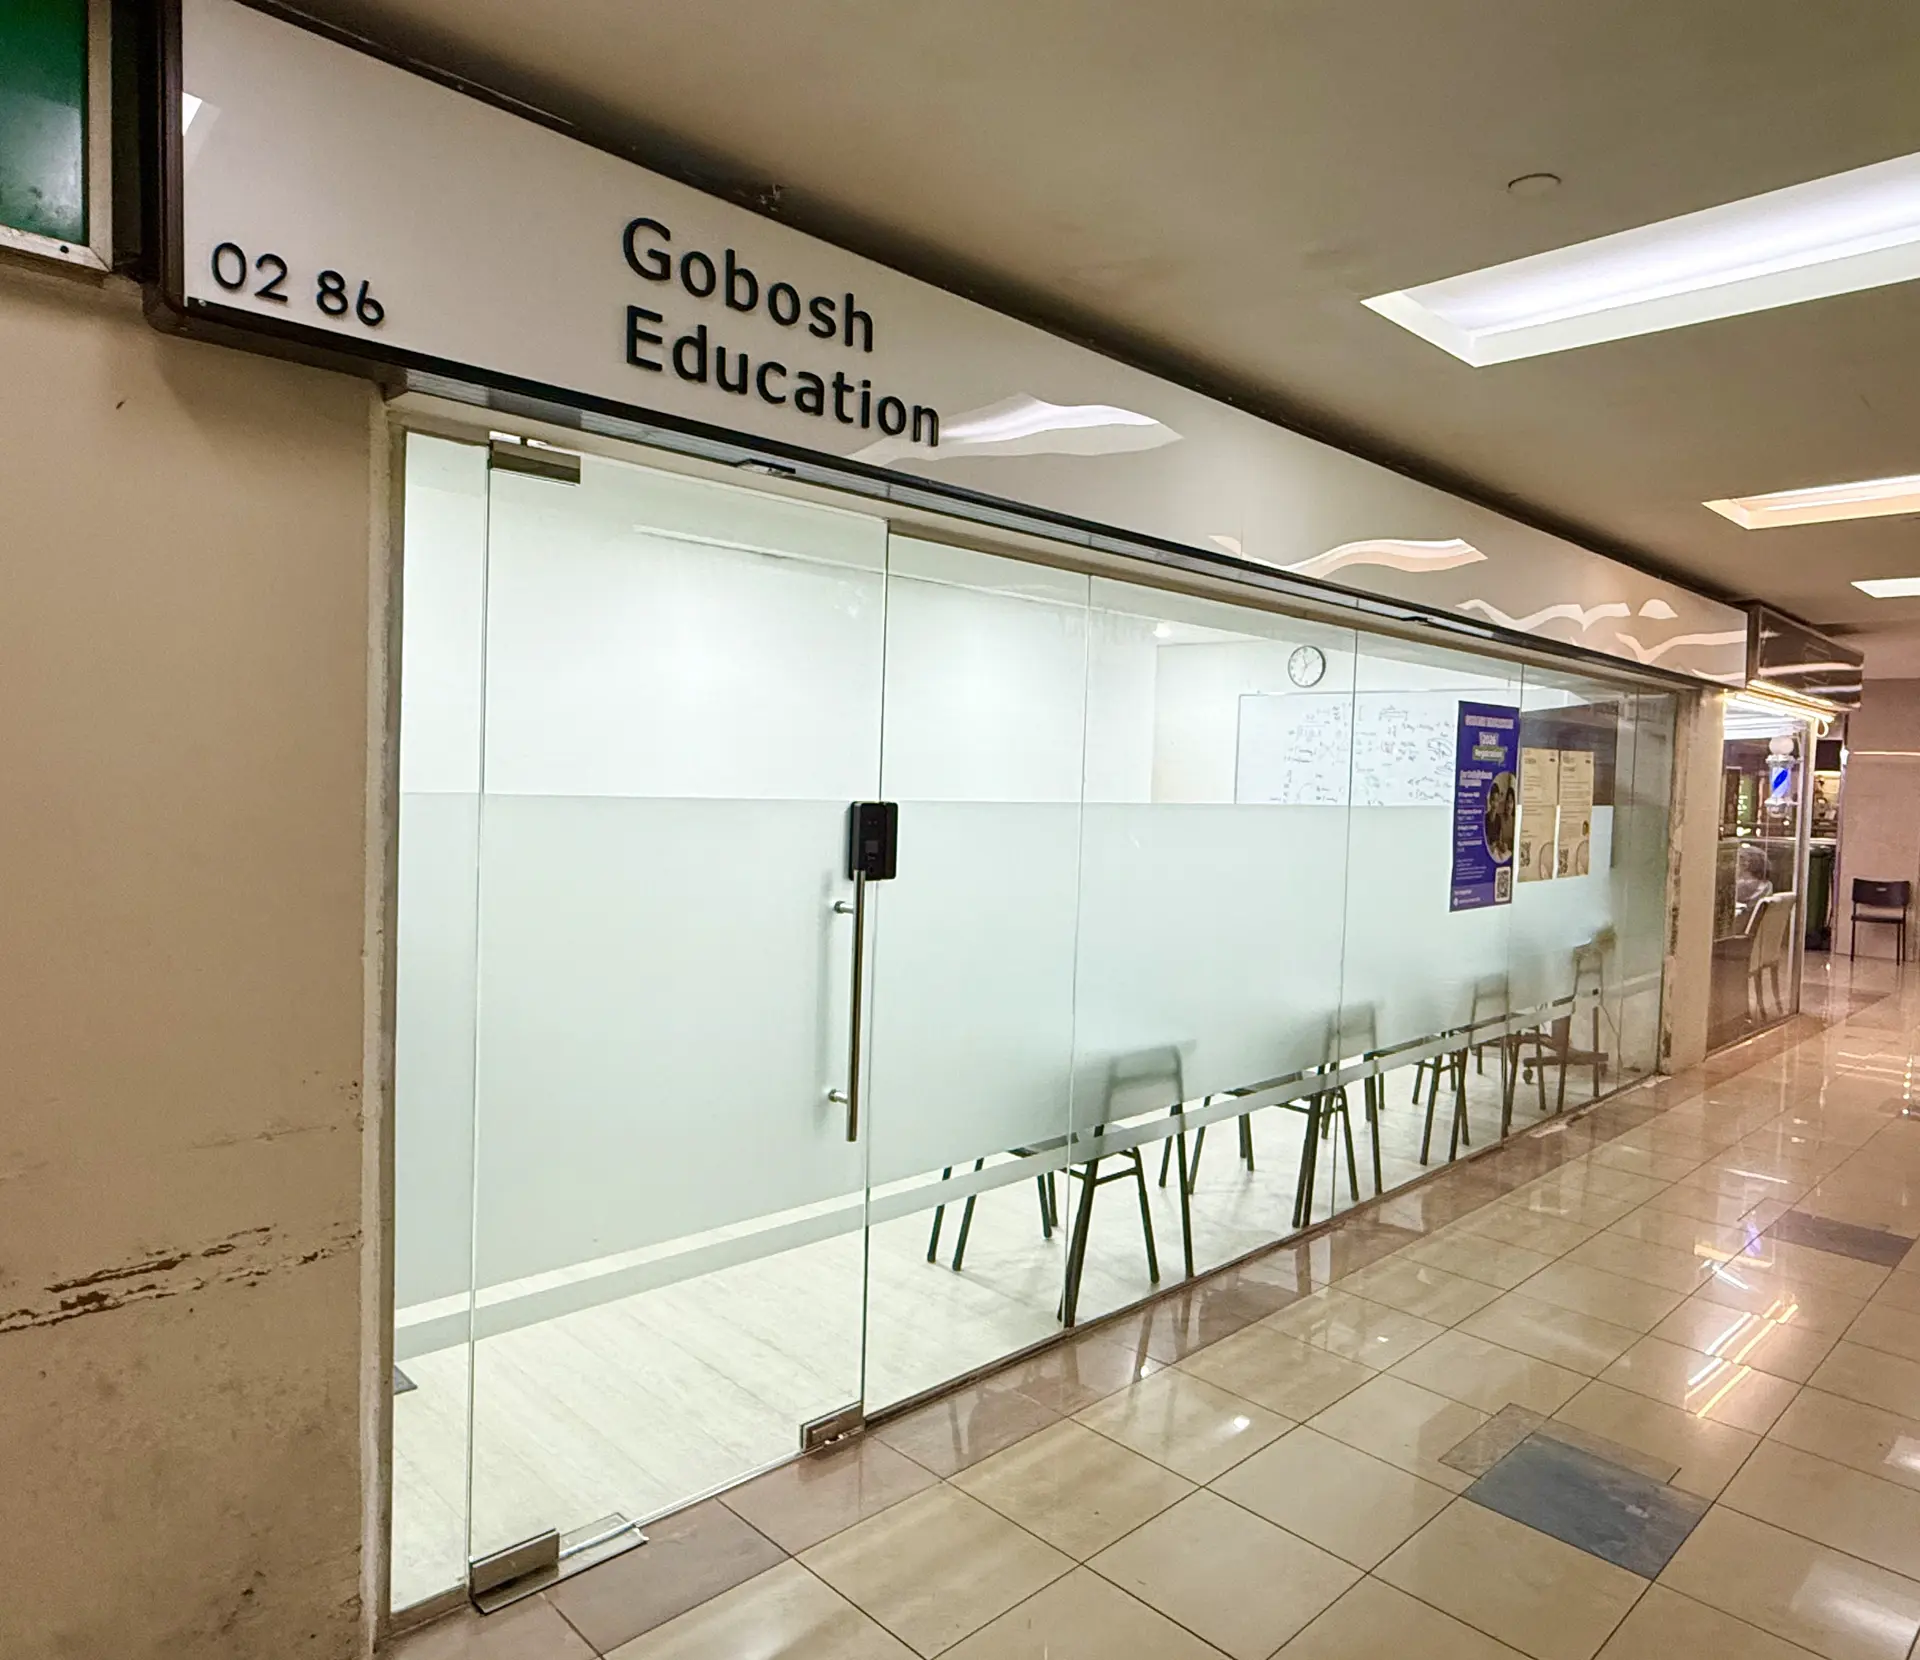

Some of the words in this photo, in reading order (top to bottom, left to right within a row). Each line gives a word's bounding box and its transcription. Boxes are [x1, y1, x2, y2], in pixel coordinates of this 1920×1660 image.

[211, 242, 288, 302] 02
[316, 270, 385, 326] 86
[623, 217, 873, 352] Gobosh
[626, 304, 939, 447] Education
